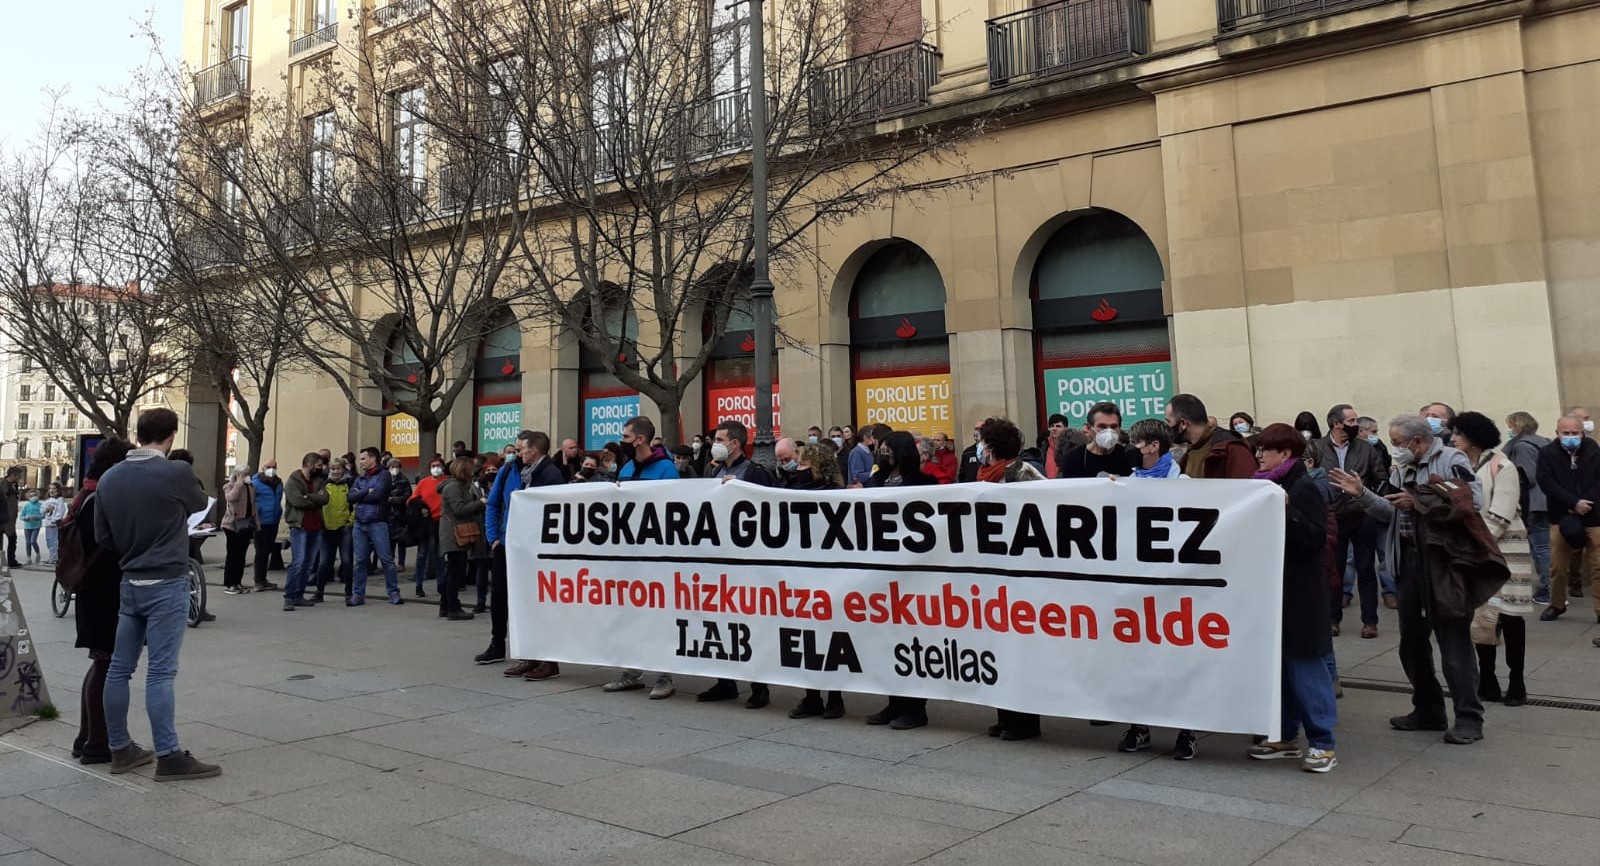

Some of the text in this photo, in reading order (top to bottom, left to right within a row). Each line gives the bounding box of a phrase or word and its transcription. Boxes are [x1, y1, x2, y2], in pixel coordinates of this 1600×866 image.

[866, 380, 950, 403] PORQUE TÚ
[1057, 369, 1165, 396] PORQUE TÚ
[484, 410, 520, 425] PORQUE
[592, 404, 634, 419] PORQUE
[867, 404, 949, 424] PORQUE TE
[1140, 397, 1165, 415] TE
[541, 501, 1222, 564] EUSKARA GUTXIESTEARI EZ
[537, 568, 1230, 648] Nafarron hizkuntza eskubideen alde
[676, 619, 998, 686] LAB ELA steilas
